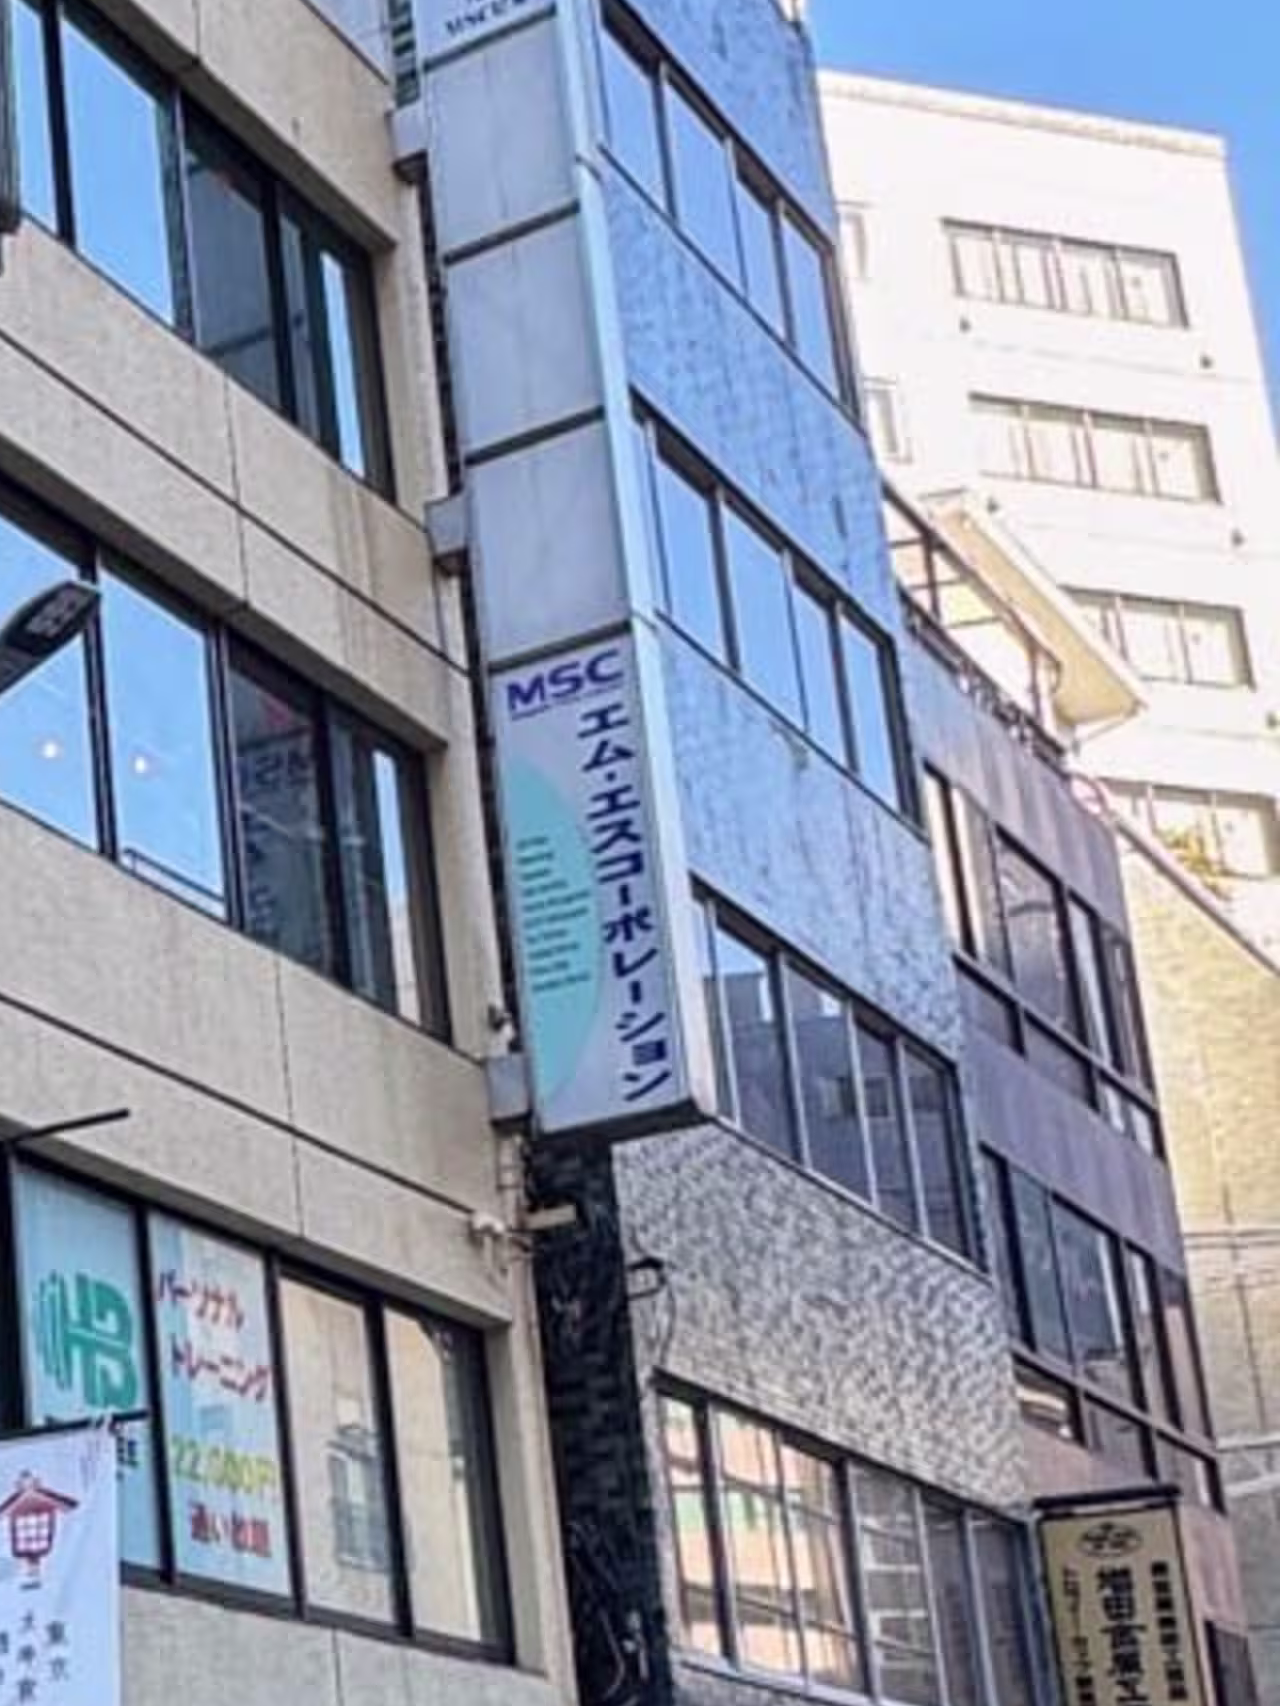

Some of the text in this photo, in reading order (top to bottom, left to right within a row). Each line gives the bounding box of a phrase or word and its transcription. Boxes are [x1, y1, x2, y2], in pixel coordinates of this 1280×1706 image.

[507, 648, 624, 711] MSC
[577, 702, 672, 1102] エム・エスコーポレーション
[169, 1335, 271, 1403] トレーニング
